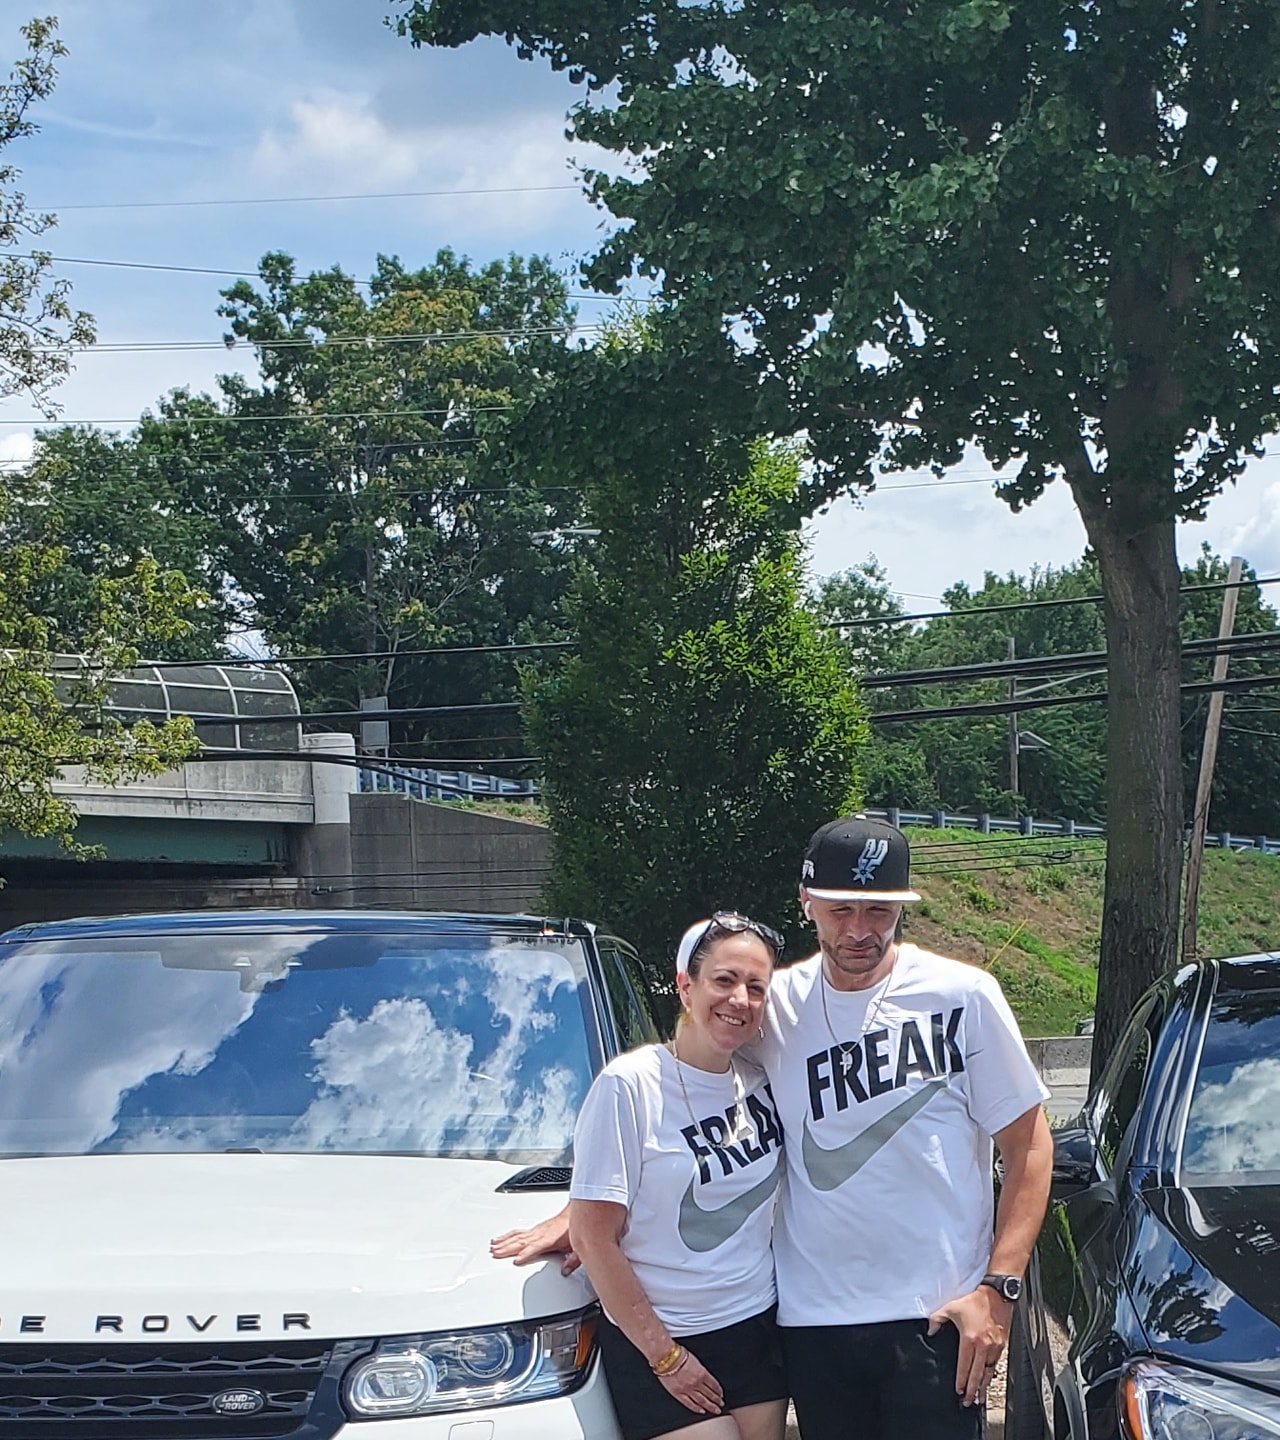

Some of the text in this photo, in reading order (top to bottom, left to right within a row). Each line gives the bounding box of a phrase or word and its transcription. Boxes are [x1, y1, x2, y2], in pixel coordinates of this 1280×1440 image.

[806, 1007, 965, 1122] FREAK
[95, 1312, 312, 1333] ROVER
[221, 1394, 248, 1402] LAND
[224, 1402, 256, 1410] ROVER
